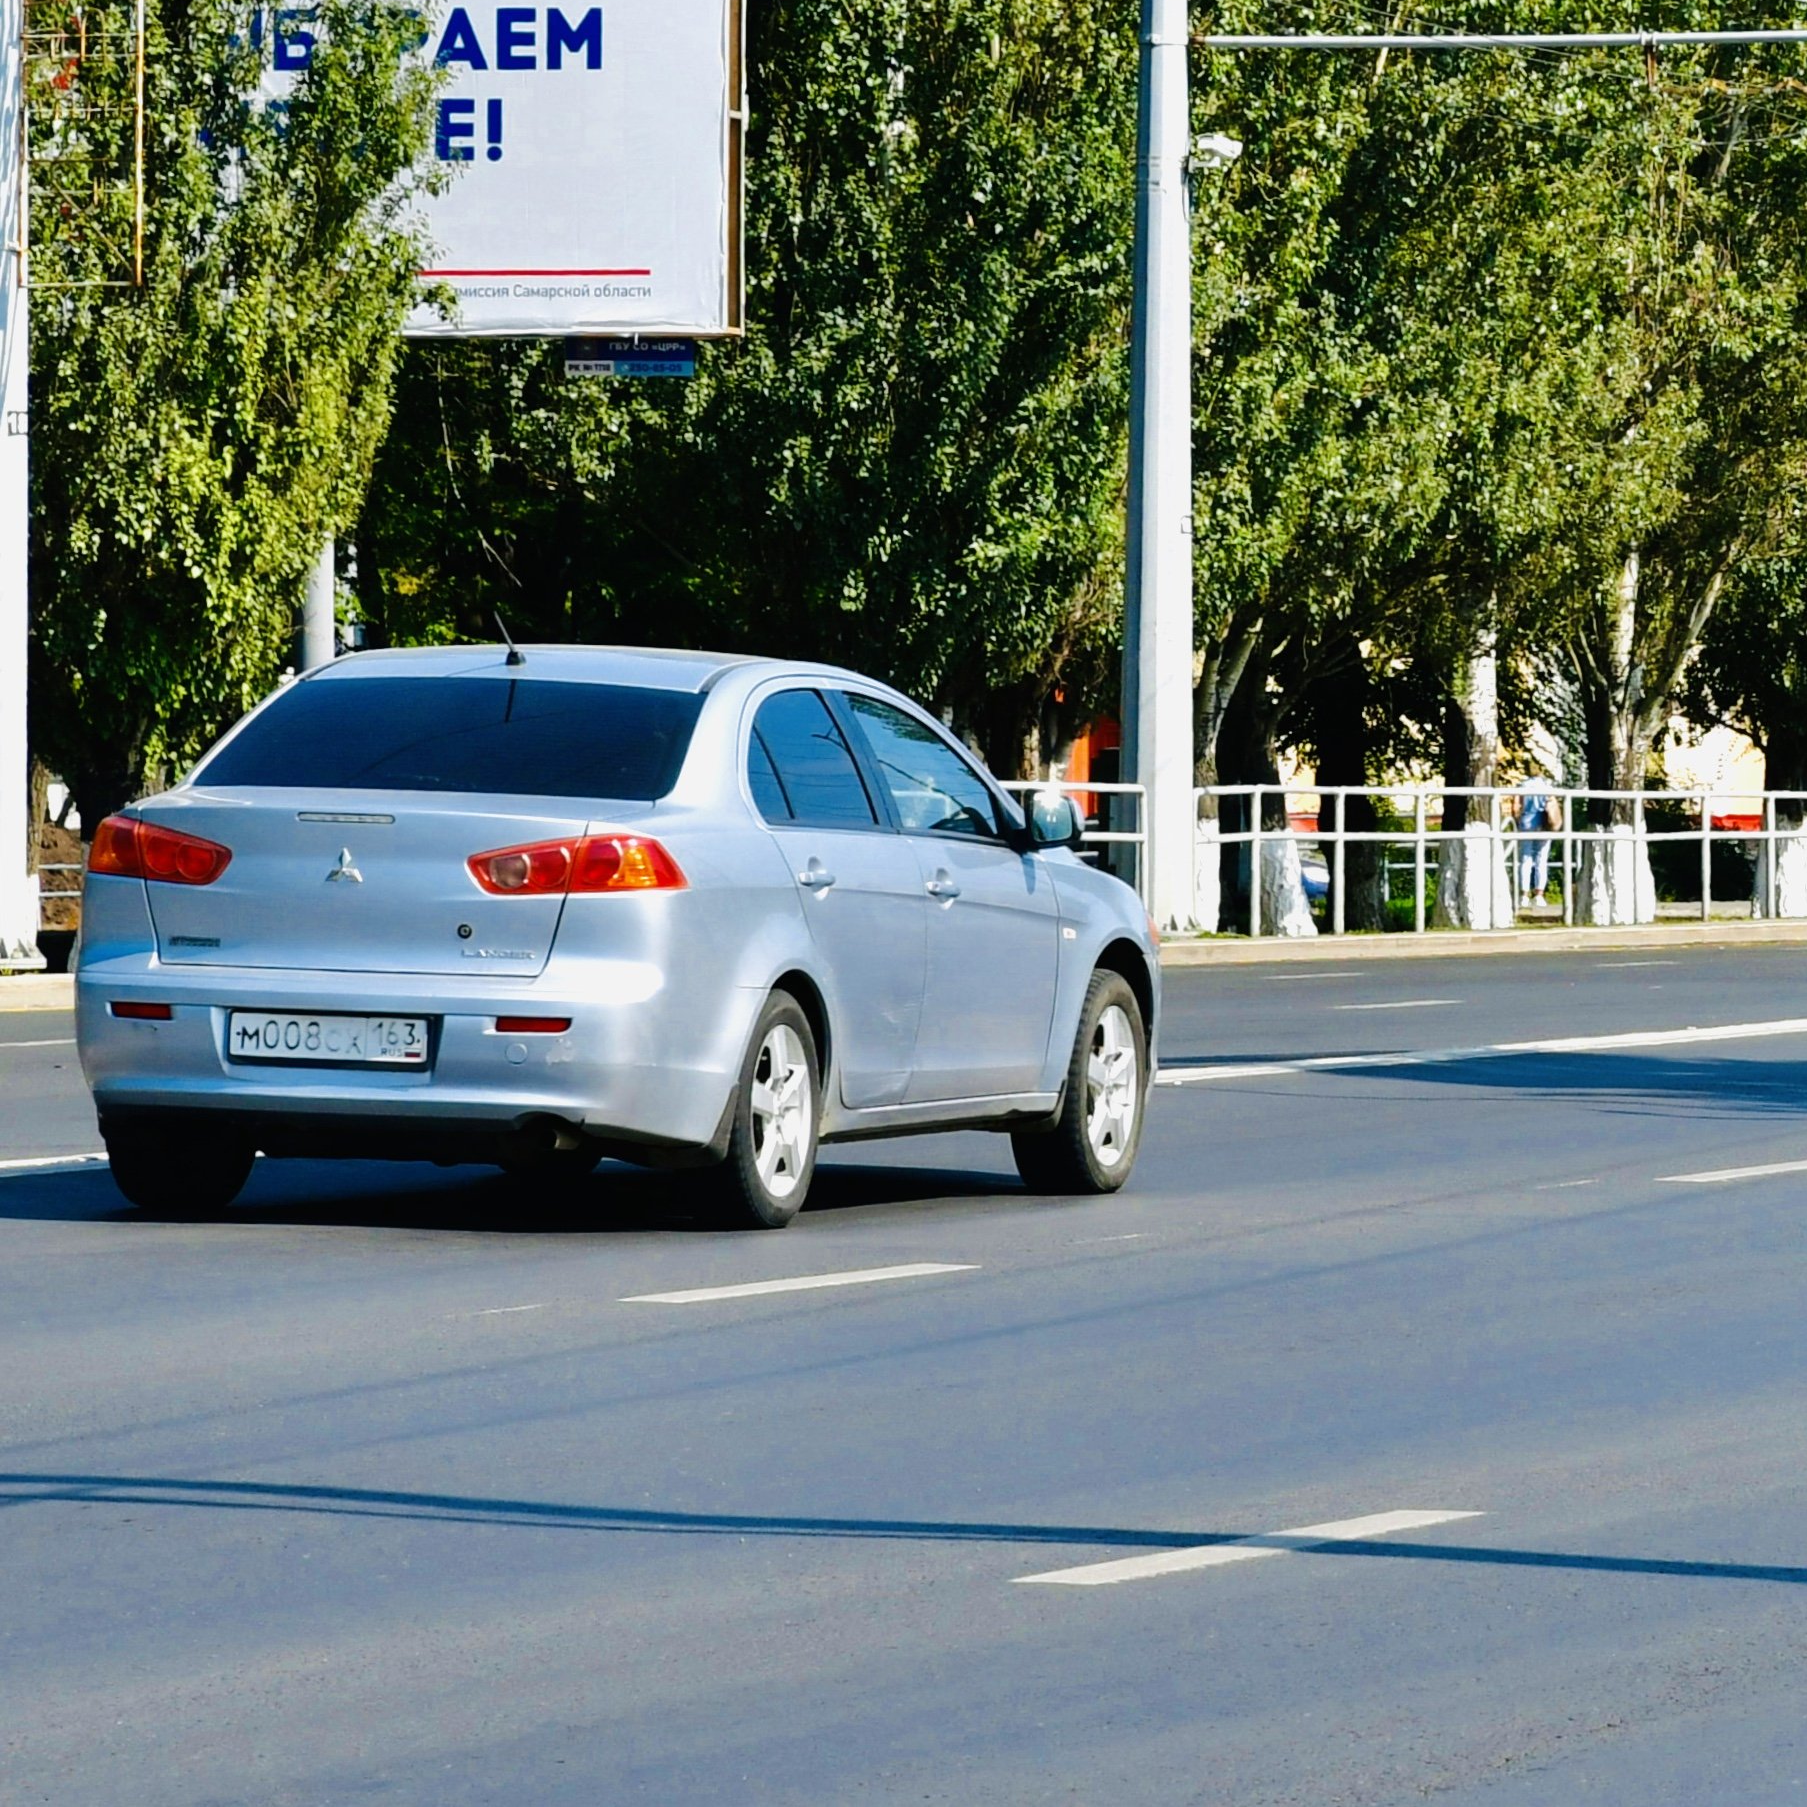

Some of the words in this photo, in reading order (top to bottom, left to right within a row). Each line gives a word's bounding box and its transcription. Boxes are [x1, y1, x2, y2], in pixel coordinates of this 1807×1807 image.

[228, 6, 604, 71] БАЕМ
[513, 283, 591, 301] Самарской
[594, 284, 652, 299] области
[372, 1021, 416, 1046] 163
